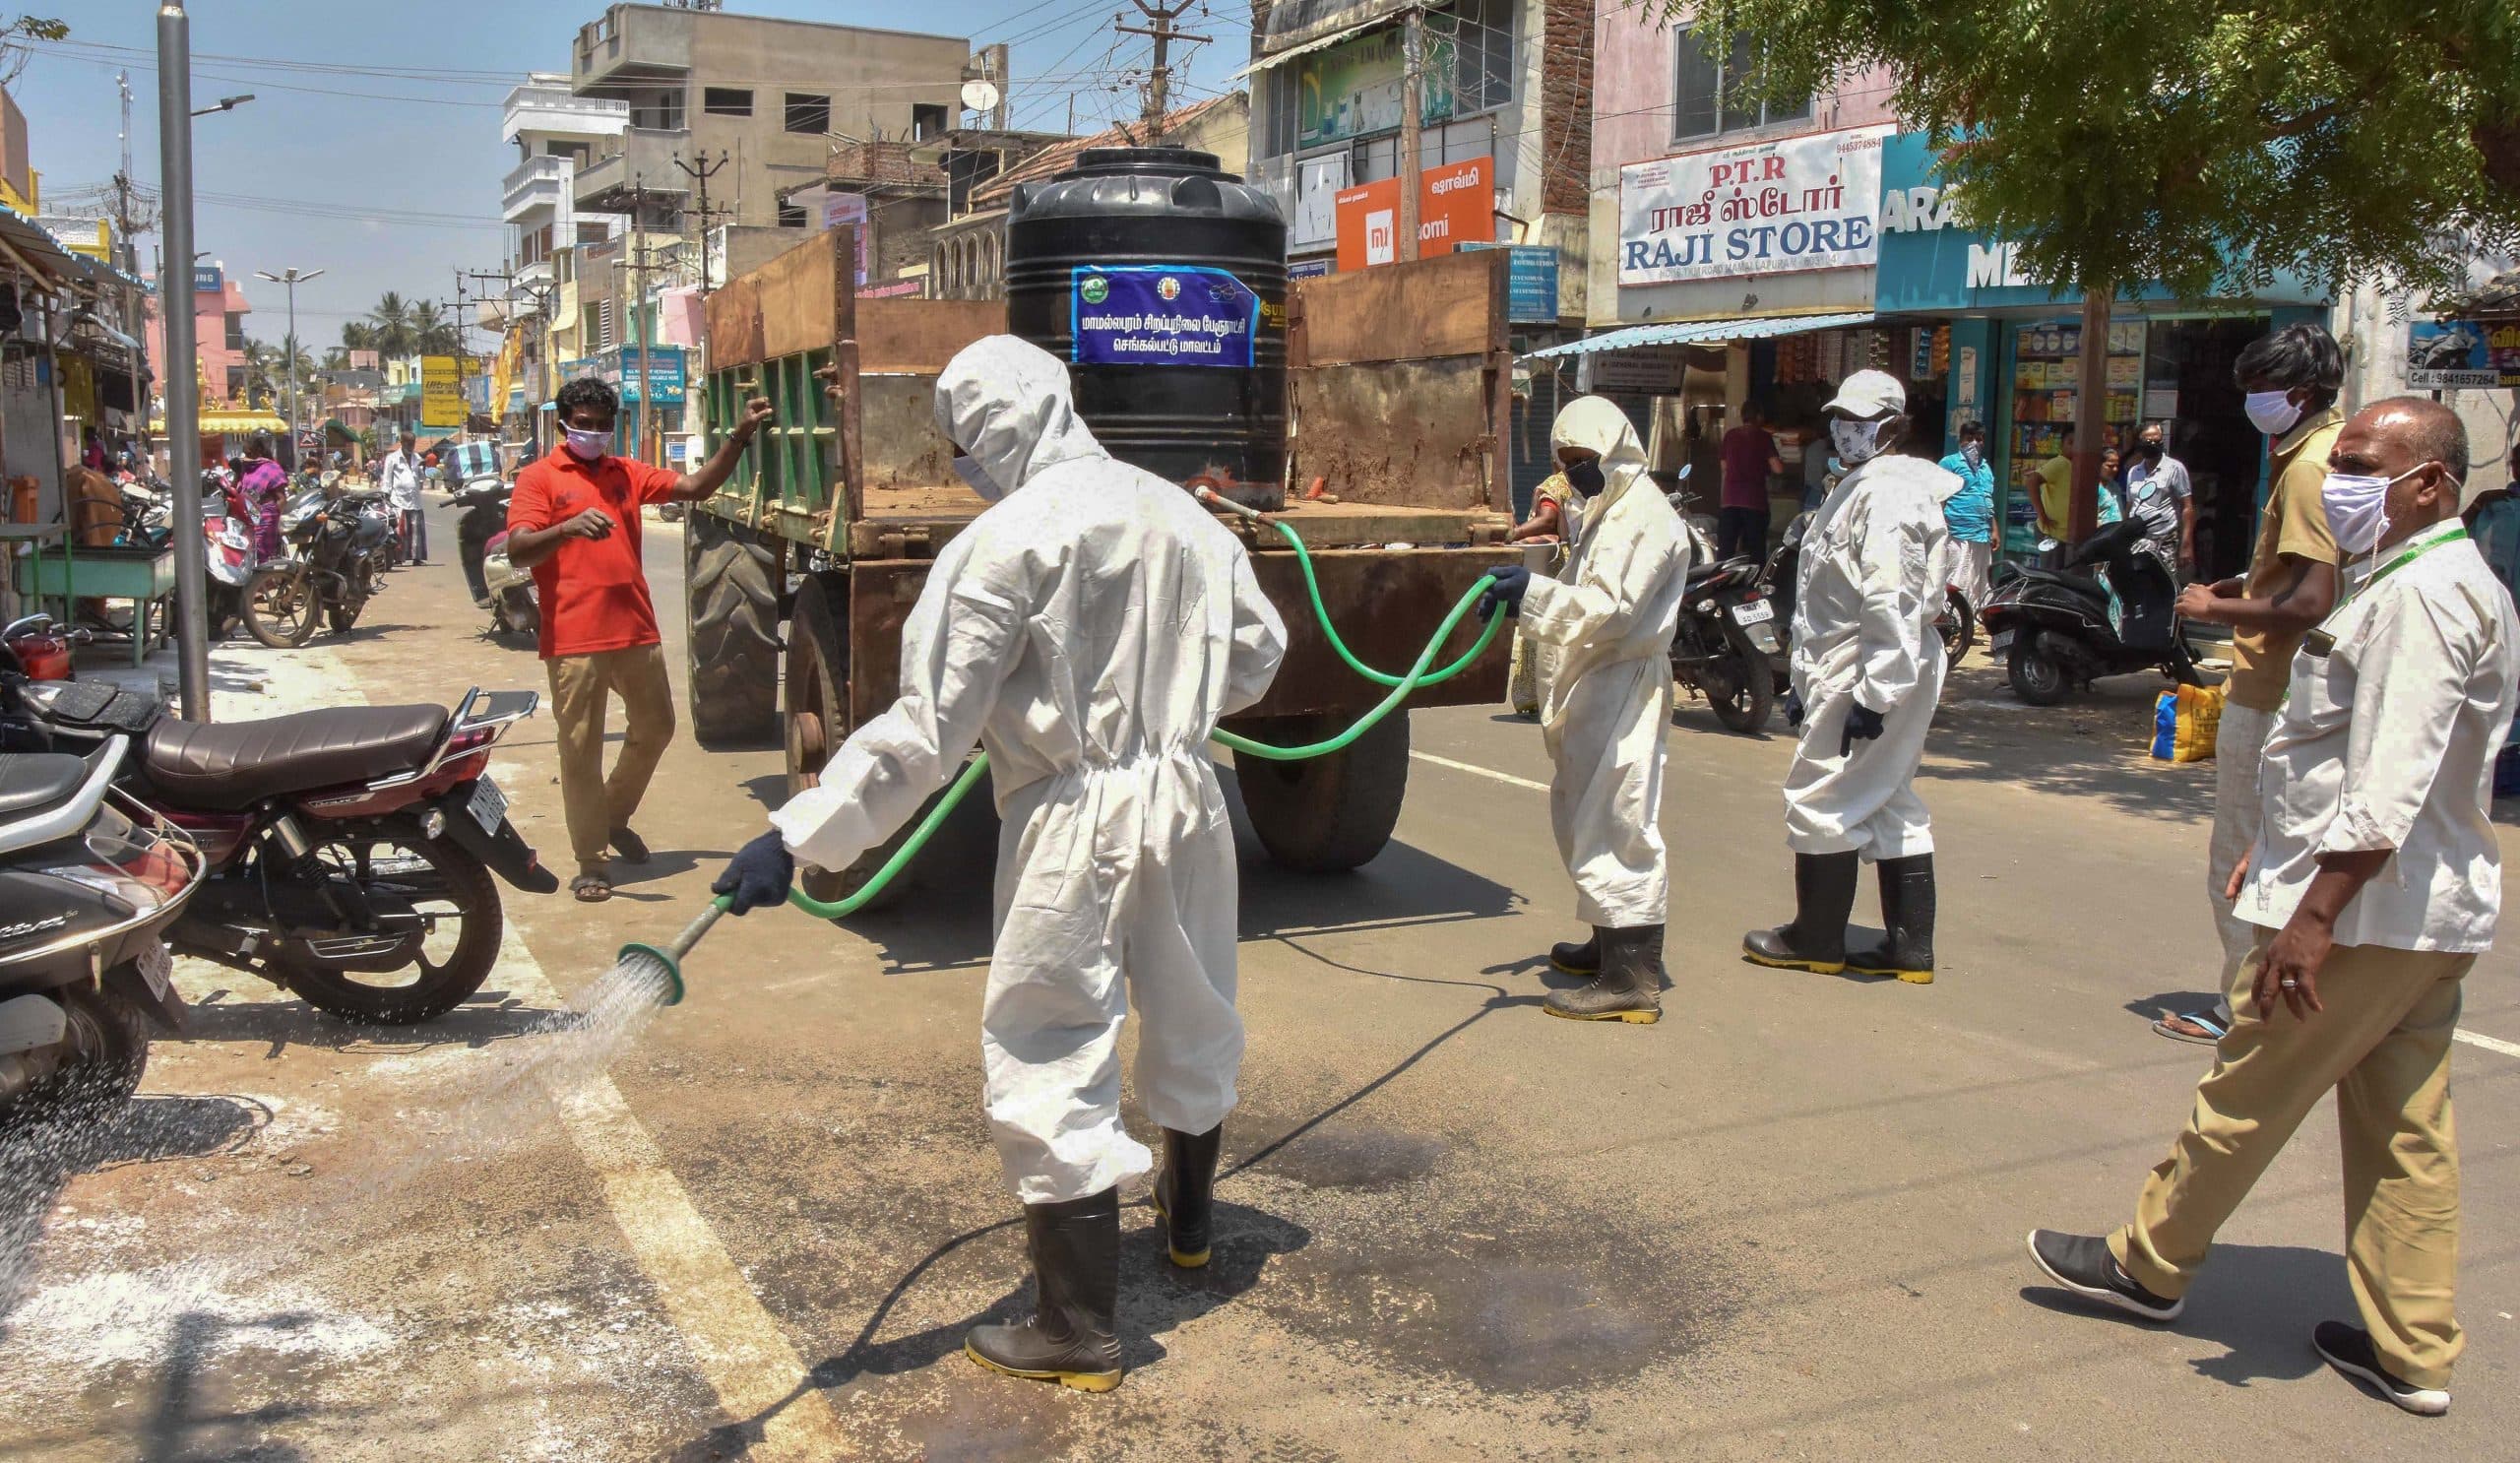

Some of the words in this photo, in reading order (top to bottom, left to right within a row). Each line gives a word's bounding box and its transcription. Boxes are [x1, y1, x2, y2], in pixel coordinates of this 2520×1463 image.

[1711, 156, 1786, 188] P.T.R
[1876, 184, 1960, 233] ARA
[1625, 233, 1715, 271] RAJI
[1726, 216, 1871, 261] STORE
[2411, 372, 2428, 383] Cell
